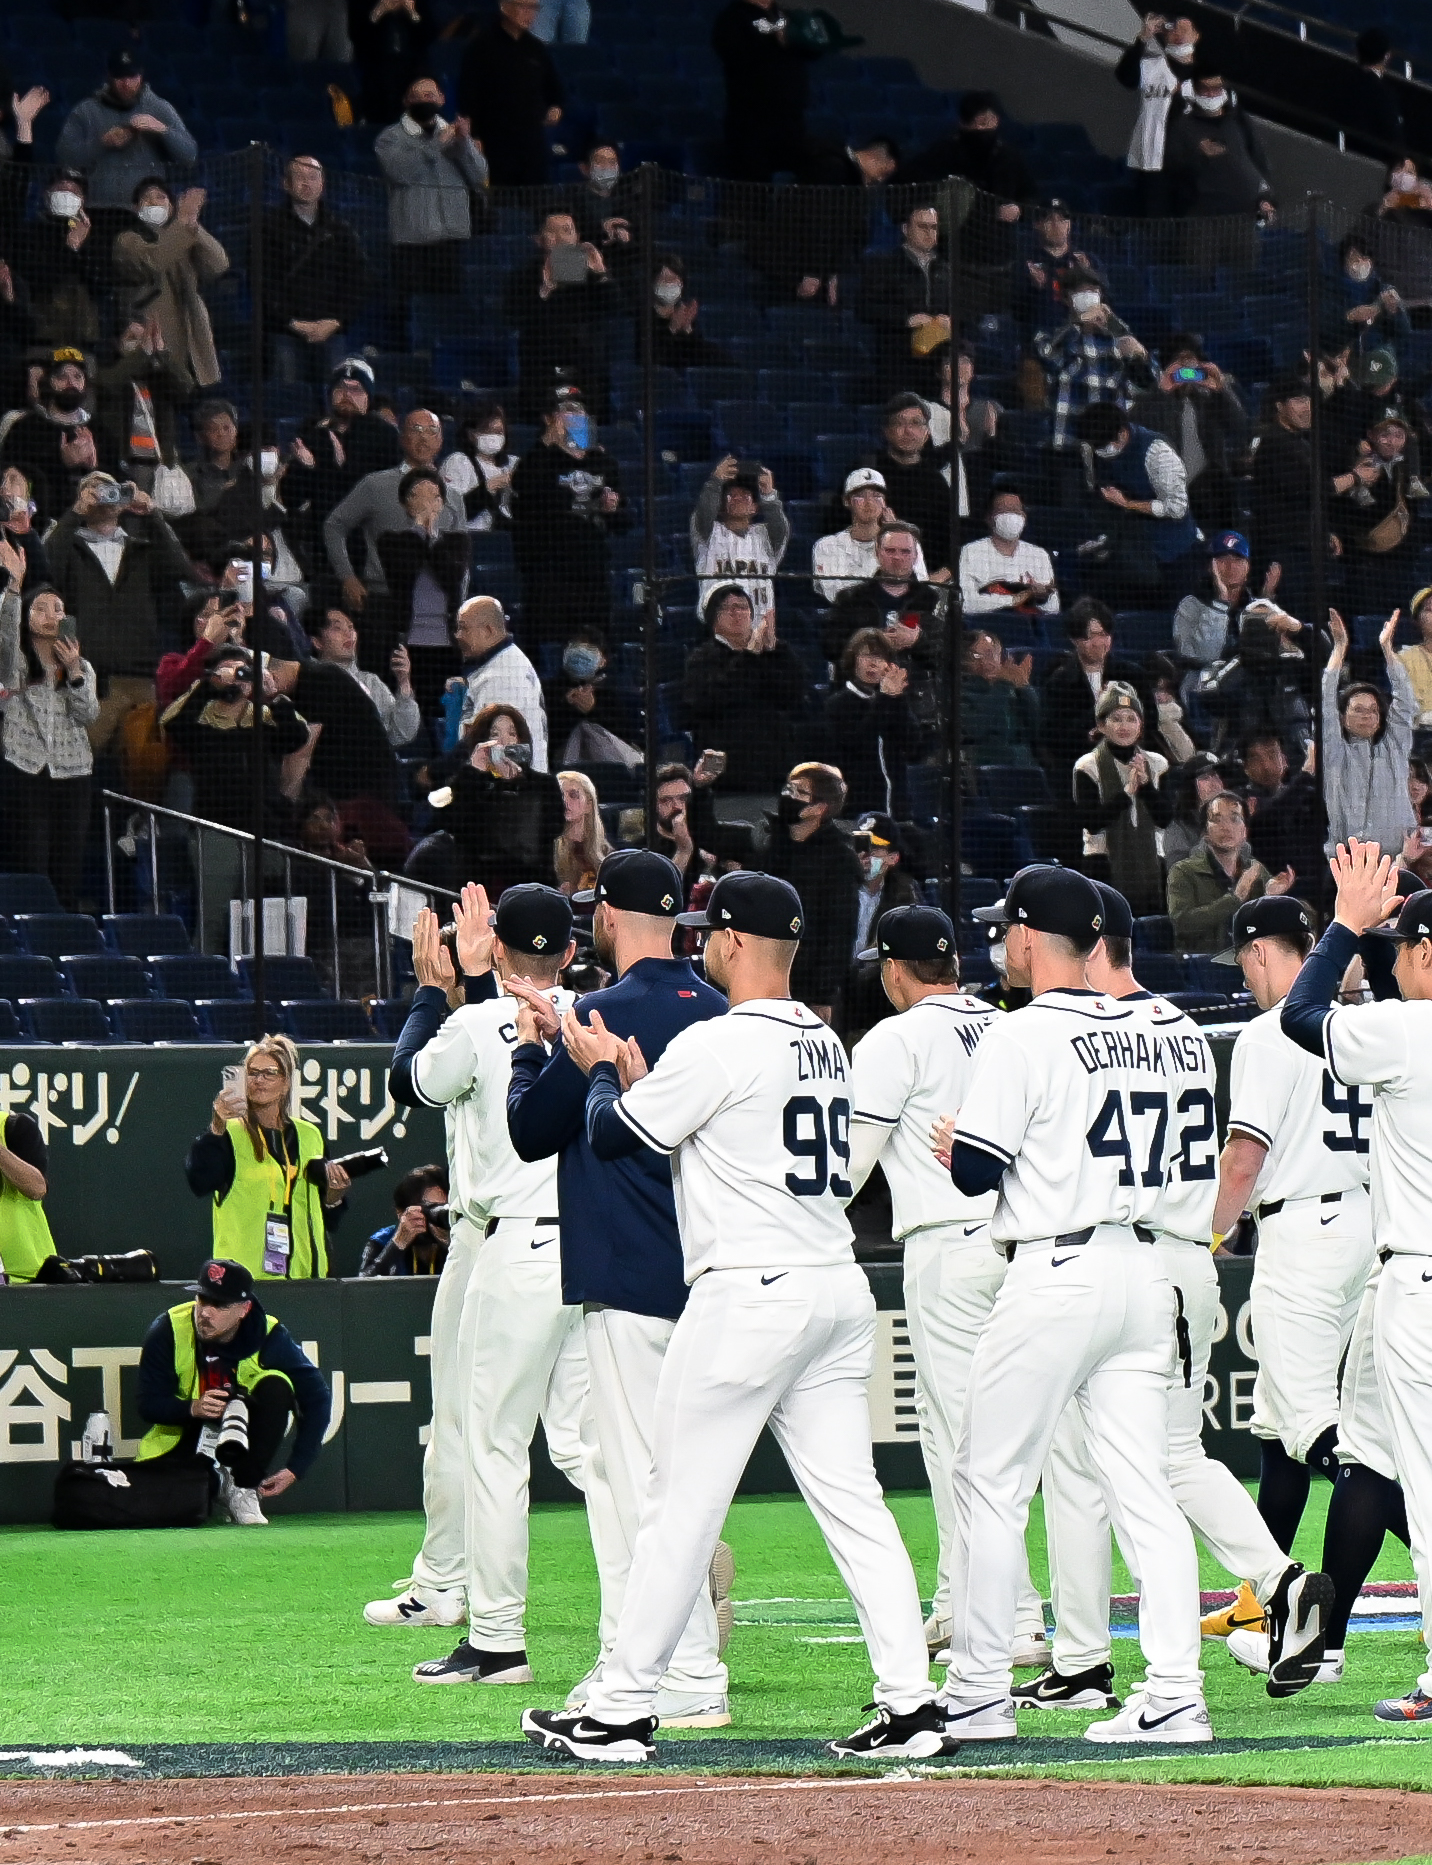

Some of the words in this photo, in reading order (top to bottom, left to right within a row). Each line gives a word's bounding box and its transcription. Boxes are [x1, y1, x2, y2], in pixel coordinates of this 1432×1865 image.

[790, 1031, 846, 1083] ZÝMA
[783, 1095, 853, 1196] 99
[1086, 1090, 1168, 1188] 47
